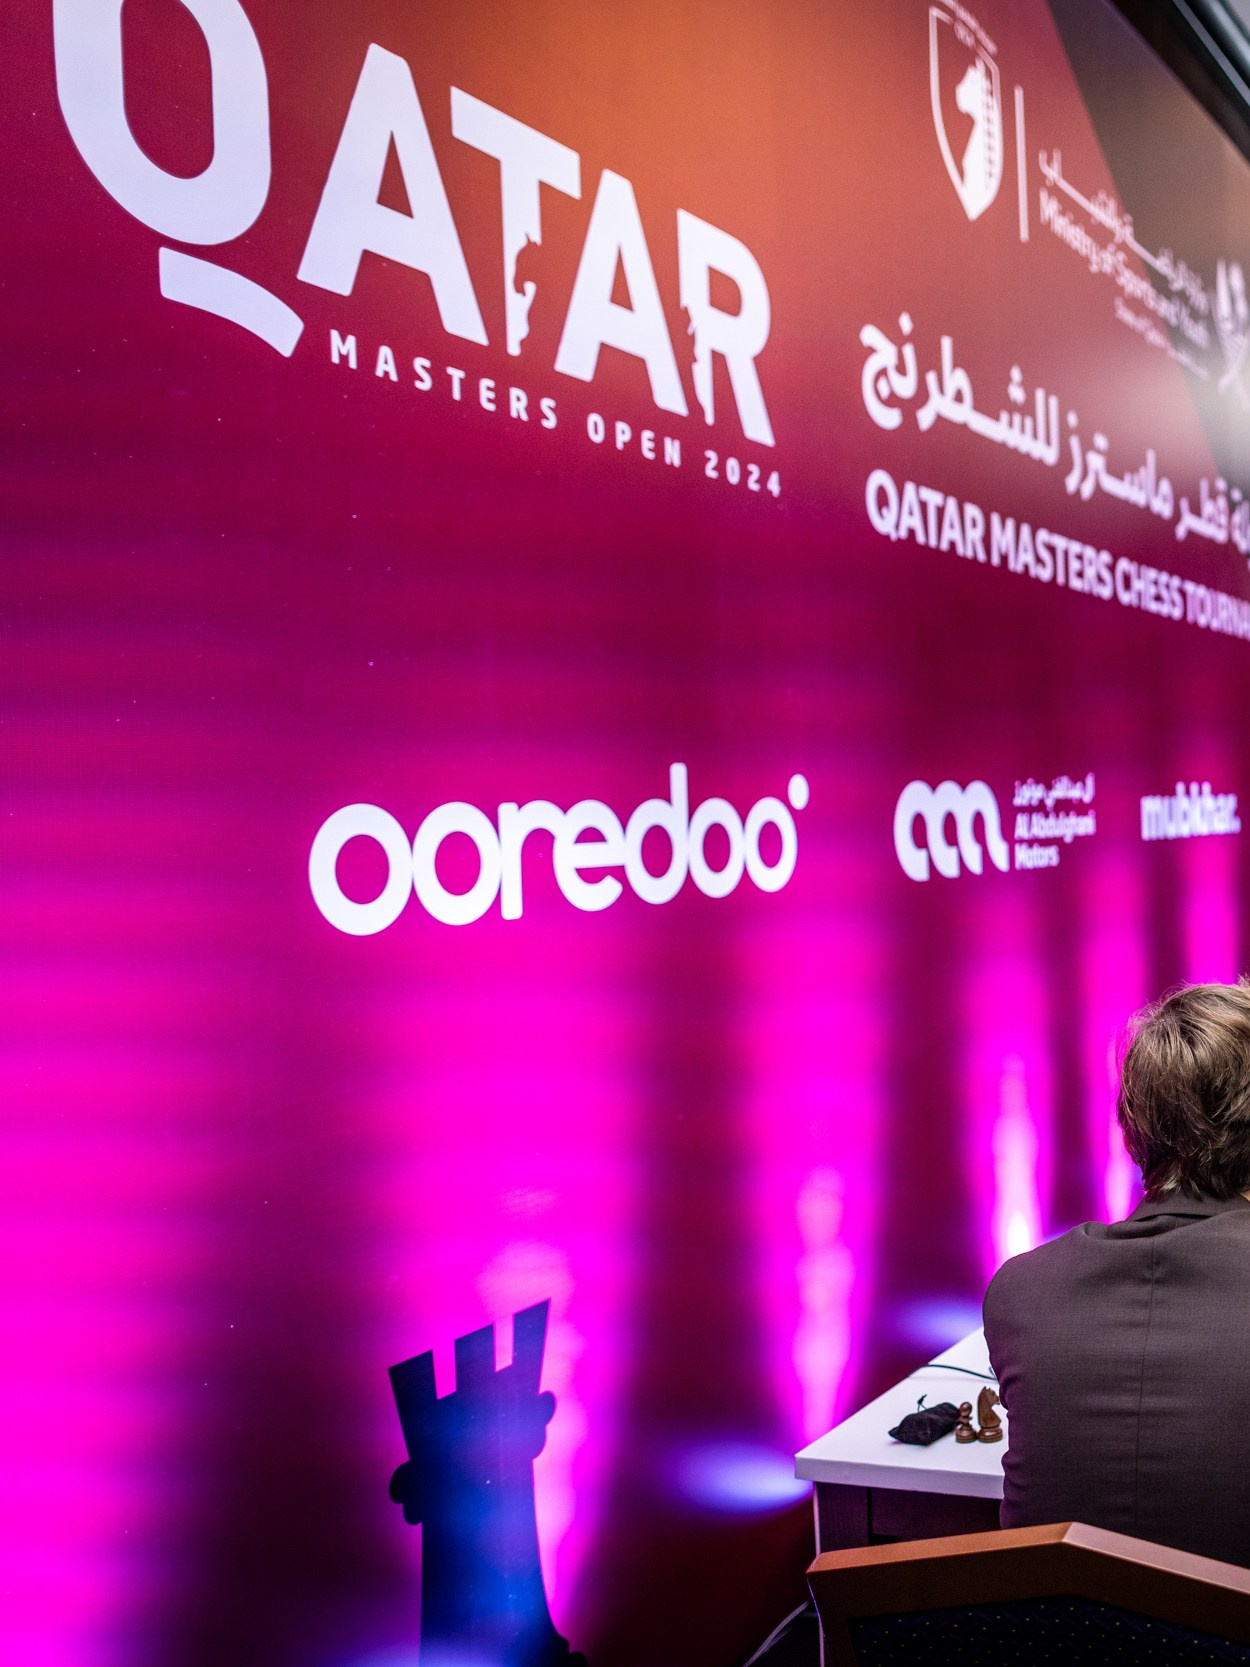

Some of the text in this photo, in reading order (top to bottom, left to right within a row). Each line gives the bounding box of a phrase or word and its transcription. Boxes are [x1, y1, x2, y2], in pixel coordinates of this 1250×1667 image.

[52, 0, 775, 446] QATAR
[330, 329, 782, 498] MASTERS OPEN 2024
[860, 312, 1060, 466] للشطرنج
[1064, 410, 1174, 520] ماسترز
[865, 469, 987, 563] QATAR
[990, 511, 1113, 600] MASTERS
[1115, 556, 1184, 621] CHESS
[1175, 477, 1229, 543] قطر
[1014, 843, 1059, 870] Motors
